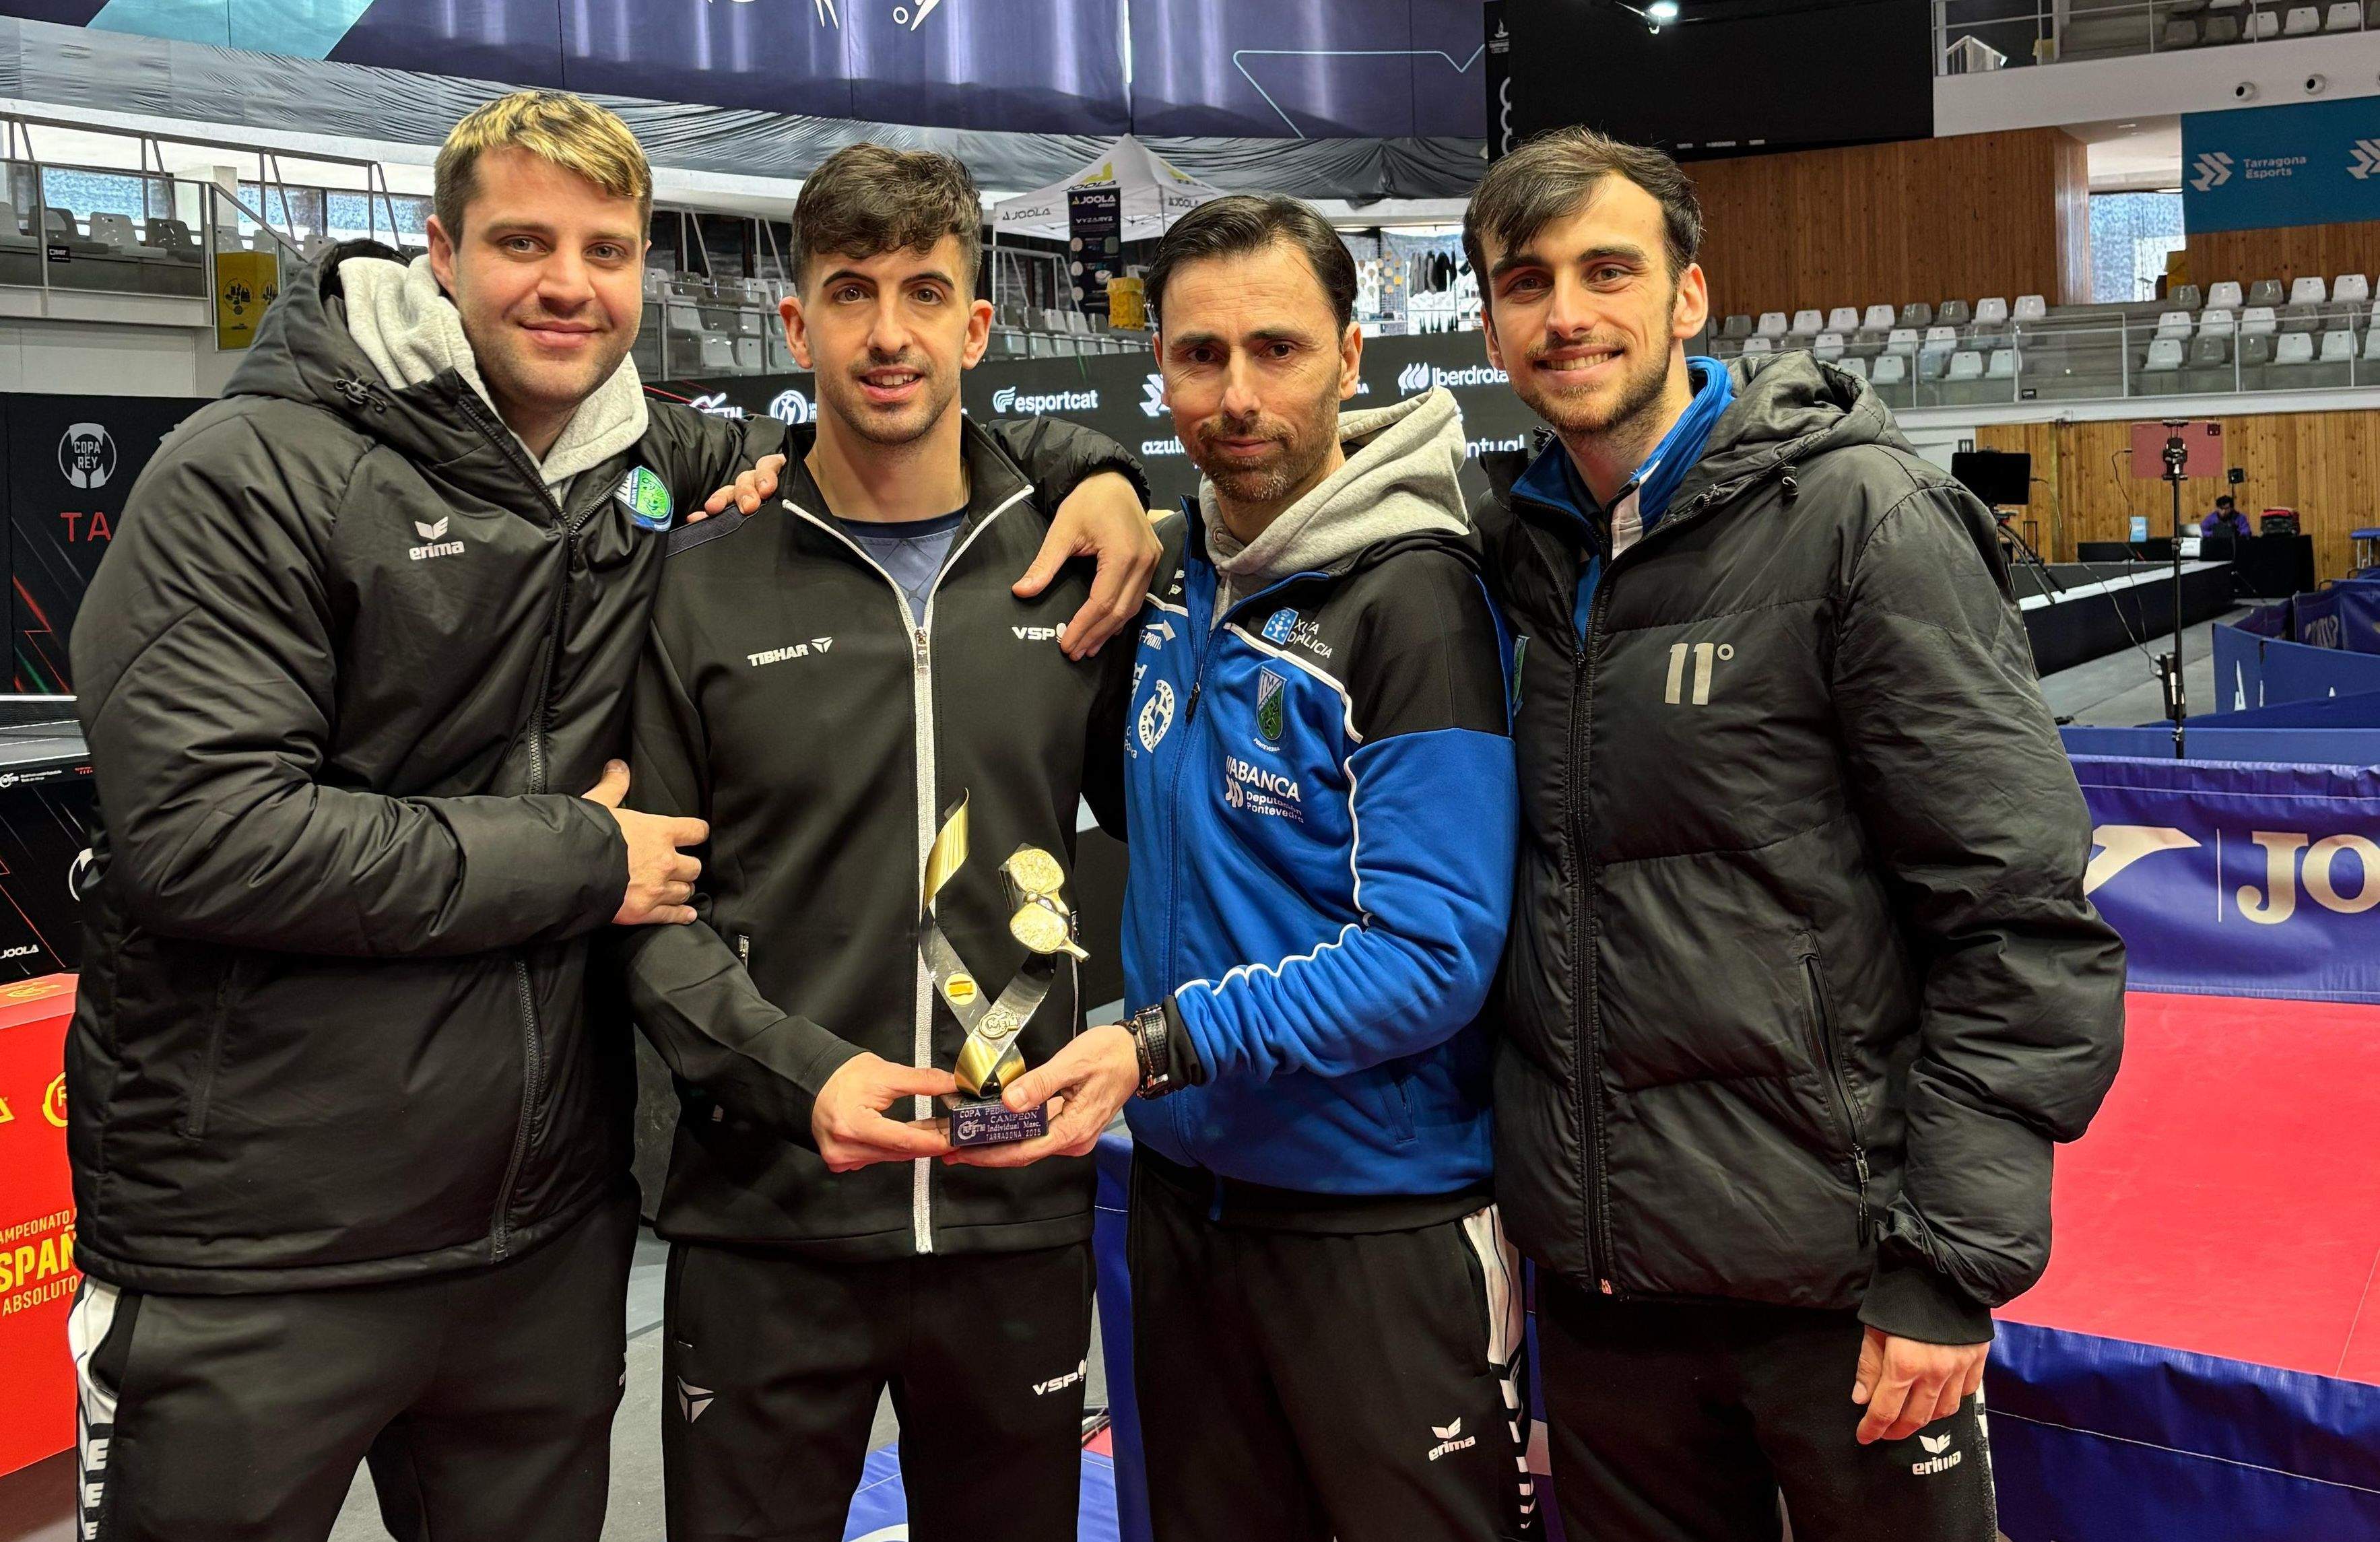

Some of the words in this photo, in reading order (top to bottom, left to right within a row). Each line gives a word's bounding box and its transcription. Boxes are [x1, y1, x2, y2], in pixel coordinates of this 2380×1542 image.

[2243, 156, 2306, 168] Tarragona
[2246, 168, 2292, 178] Esports
[1081, 195, 1116, 205] JOOLA
[1012, 207, 1051, 220] JOOLA
[1432, 365, 1510, 387] Iberdrola
[1014, 389, 1098, 415] esportcat
[74, 441, 100, 454] COPA
[1142, 436, 1185, 455] azul
[1465, 434, 1525, 459] ntual
[77, 457, 98, 469] REY
[60, 512, 112, 542] TA
[409, 541, 465, 560] erima
[748, 644, 809, 667] TIBHAR
[1226, 755, 1300, 802] ABANCA
[2237, 830, 2380, 925] JO
[960, 1110, 981, 1118] COPA
[985, 1106, 1010, 1116] PEDR
[987, 1122, 1020, 1132] Individual
[0, 1209, 70, 1244] AMPEONATO
[0, 1223, 77, 1293] SPAÑ
[2, 1275, 78, 1317] ABSOLUTO
[1428, 1436, 1475, 1462] erima
[1912, 1450, 1961, 1475] erima
